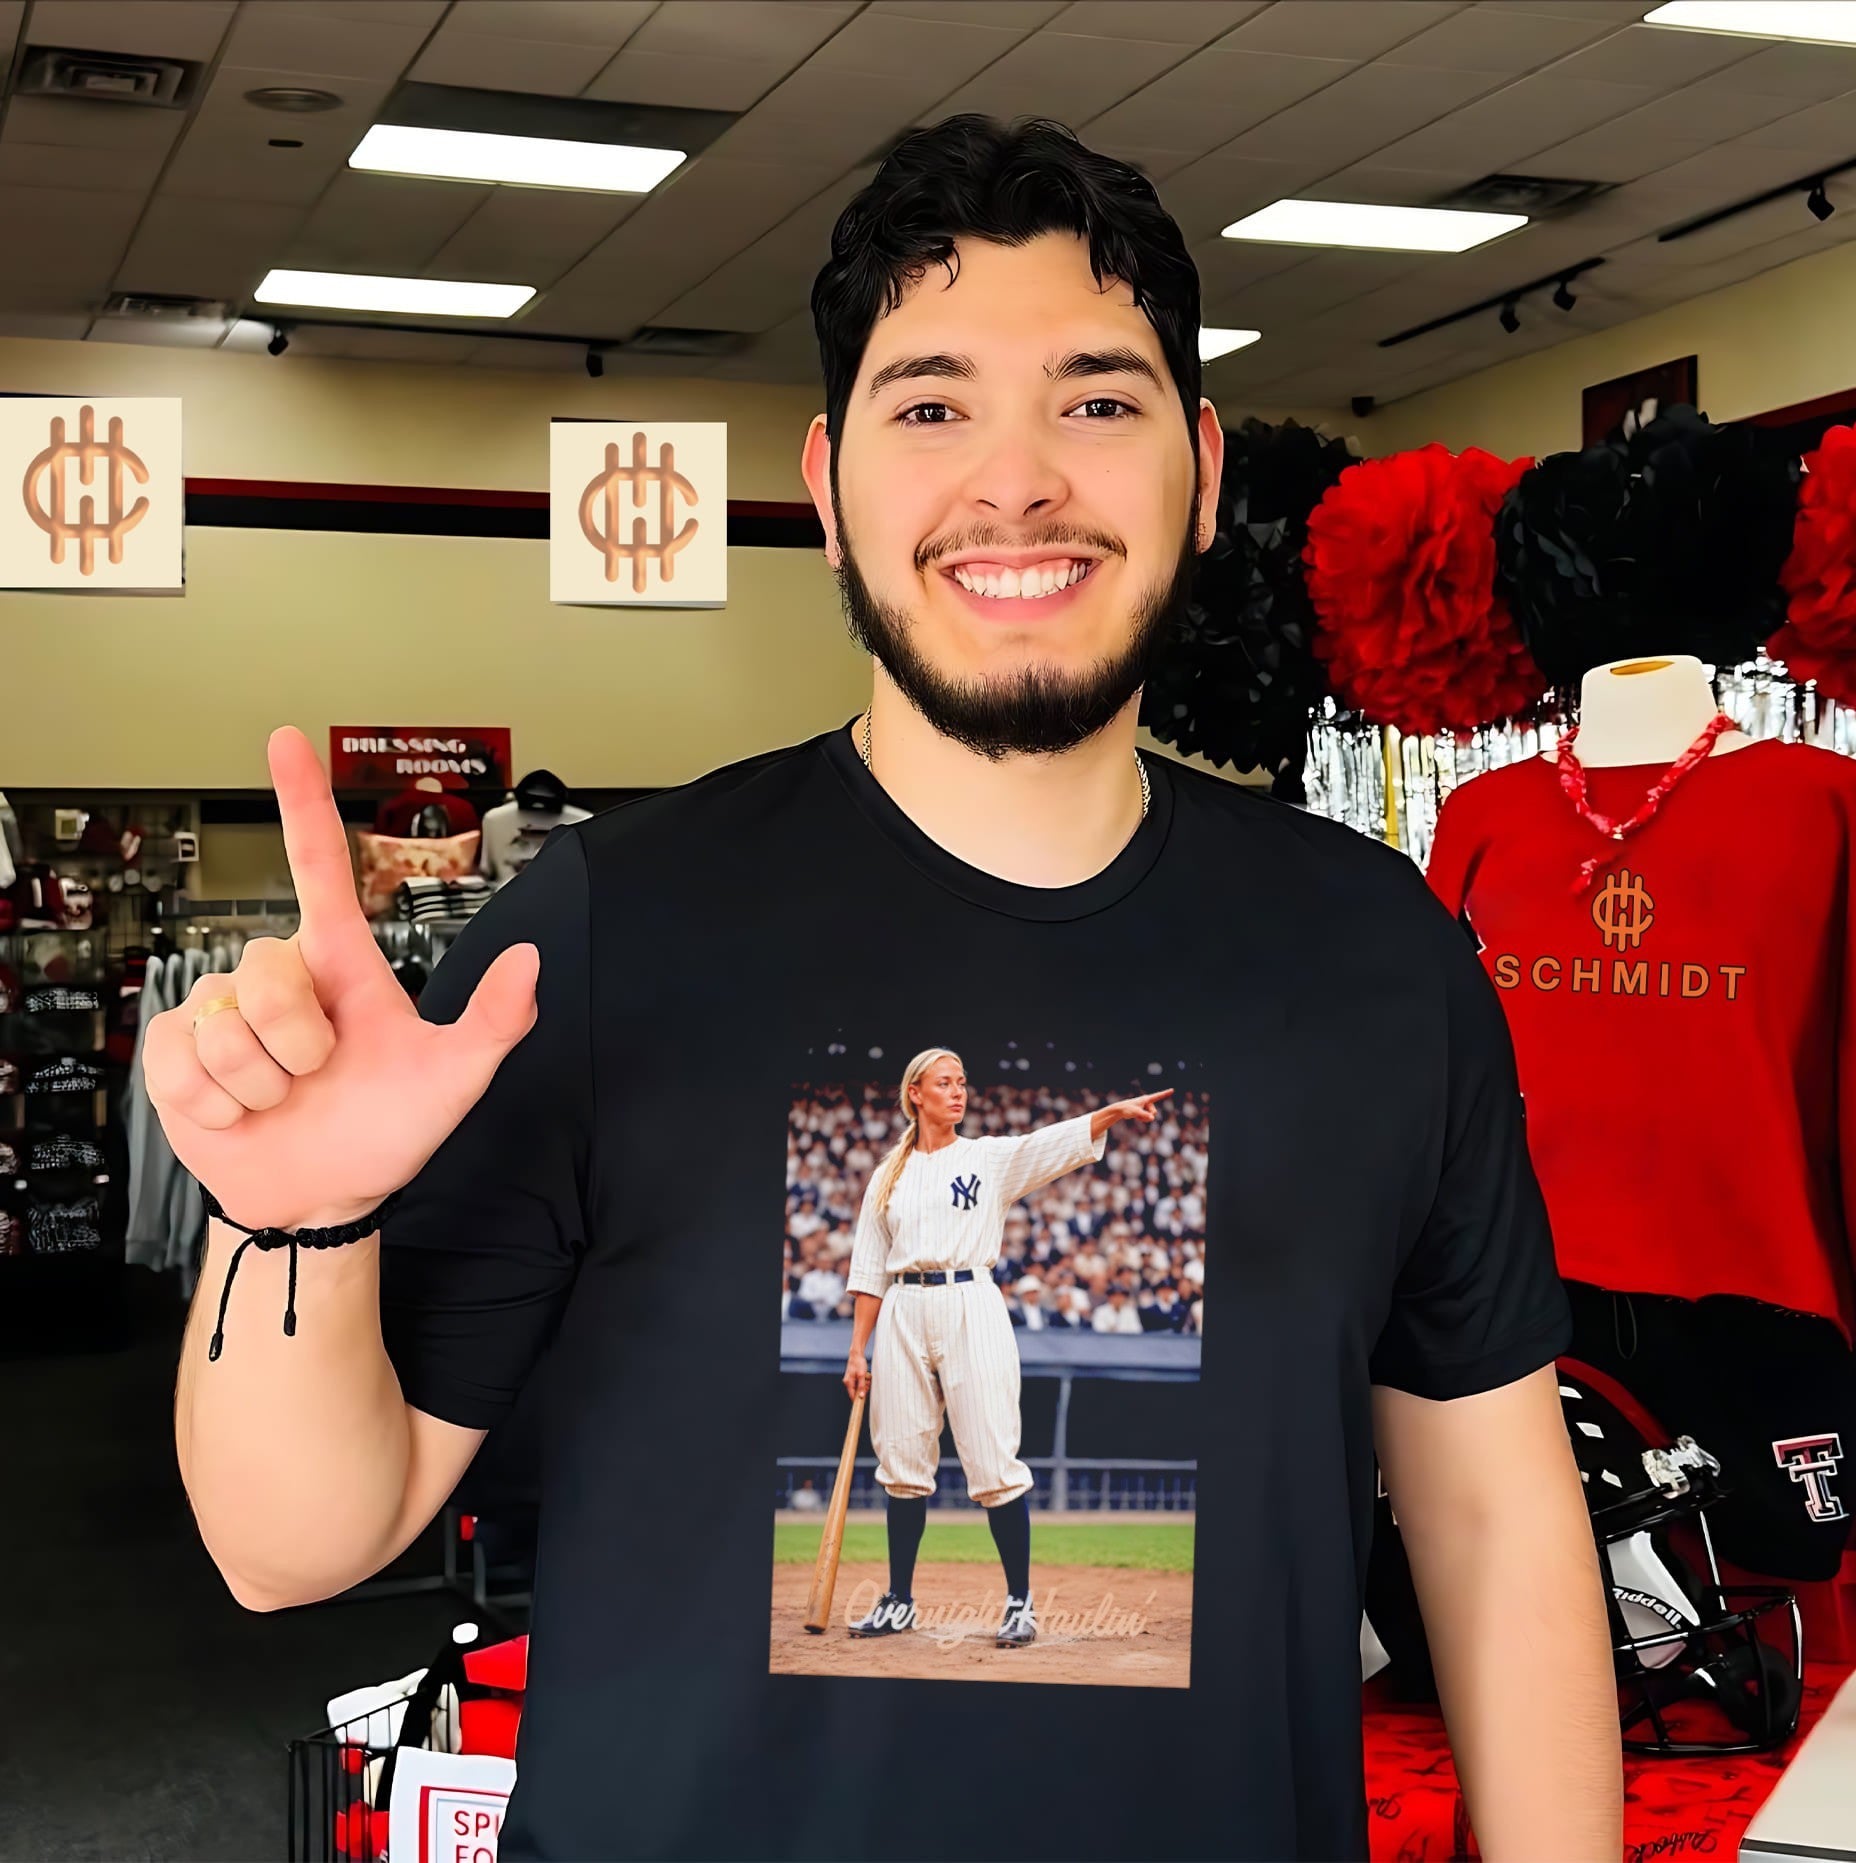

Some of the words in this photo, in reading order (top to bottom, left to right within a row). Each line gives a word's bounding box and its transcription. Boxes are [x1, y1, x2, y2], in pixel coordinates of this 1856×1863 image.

[342, 737, 467, 754] DRESSING
[395, 759, 487, 774] ROOMS
[1493, 953, 1747, 1001] SCHMIDT
[950, 1173, 982, 1211] NY
[844, 1578, 1024, 1649] Overnight
